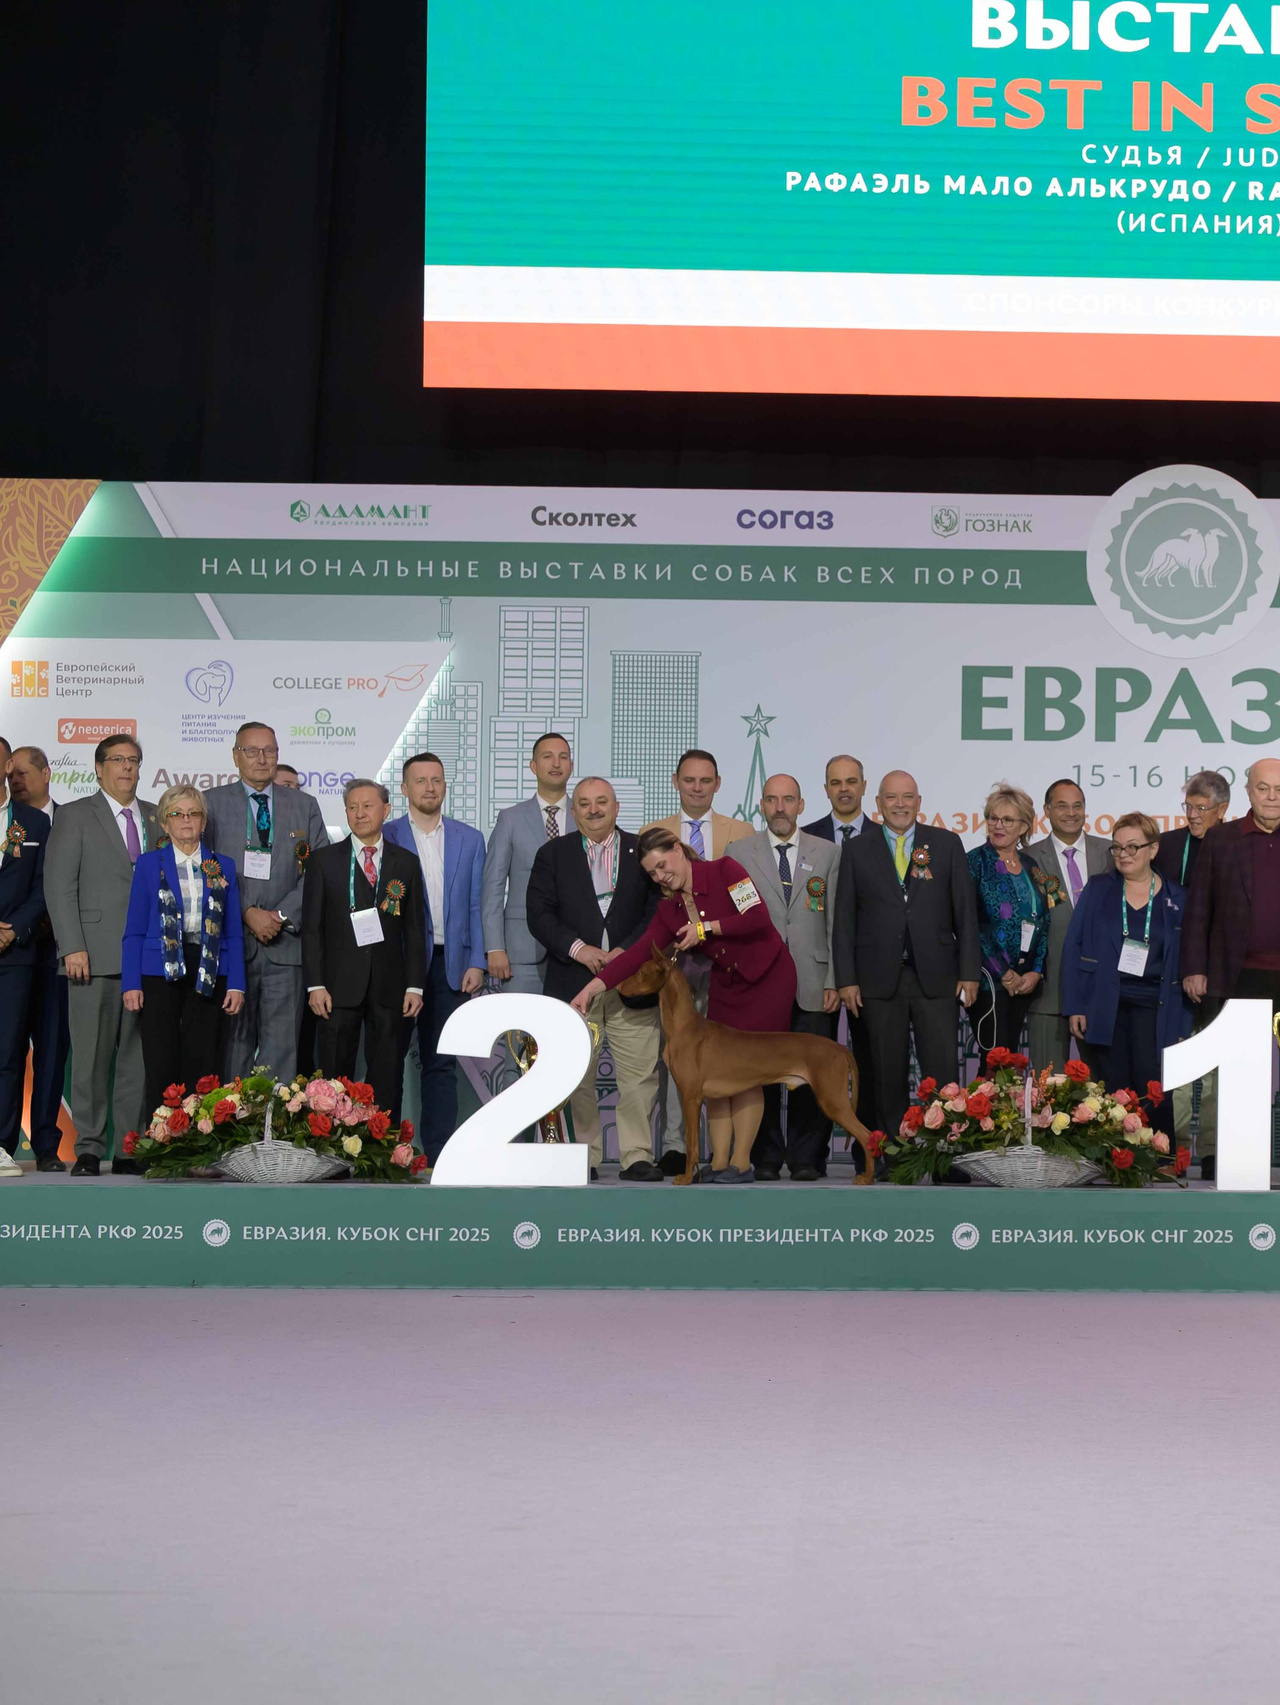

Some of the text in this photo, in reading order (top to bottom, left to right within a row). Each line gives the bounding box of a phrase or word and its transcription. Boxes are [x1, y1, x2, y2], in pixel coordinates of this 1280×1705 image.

[901, 76, 1102, 129] BEST
[1132, 81, 1213, 132] IN
[1082, 144, 1181, 167] СУДЬЯ
[786, 172, 930, 194] РАФАЭЛЬ
[944, 175, 1032, 196] МАЛО
[1046, 178, 1211, 202] АЛЬКРУДО
[531, 506, 637, 527] Сколтех
[966, 519, 1032, 532] ГОЗНАК
[203, 558, 1021, 589] НАЦИОНАЛЬНЫЕ ВЫСТАВКИ СОБАК ВСЕХ ПОРОД
[56, 662, 135, 674] Европейский
[56, 675, 145, 685] Ветеринарный
[273, 677, 378, 690] COLLEGE PRO
[56, 688, 92, 698] Центр
[78, 725, 132, 735] neoterica
[290, 726, 356, 739] экопром
[1072, 764, 1163, 788] 15-16
[430, 993, 588, 1185] 2
[1163, 999, 1273, 1191] 1
[97, 1224, 136, 1240] РКФ
[142, 1226, 183, 1239] 2025
[244, 1226, 489, 1241] ЕВРАЗИЯ. КУБОК СНГ 2025
[558, 1229, 934, 1245] ЕВРАЗИЯ. КУБОК ПРЕЗИДЕНТА РКФ 2025
[992, 1230, 1233, 1243] ЕВРАЗИЯ. КУБОК СНГ 2025
